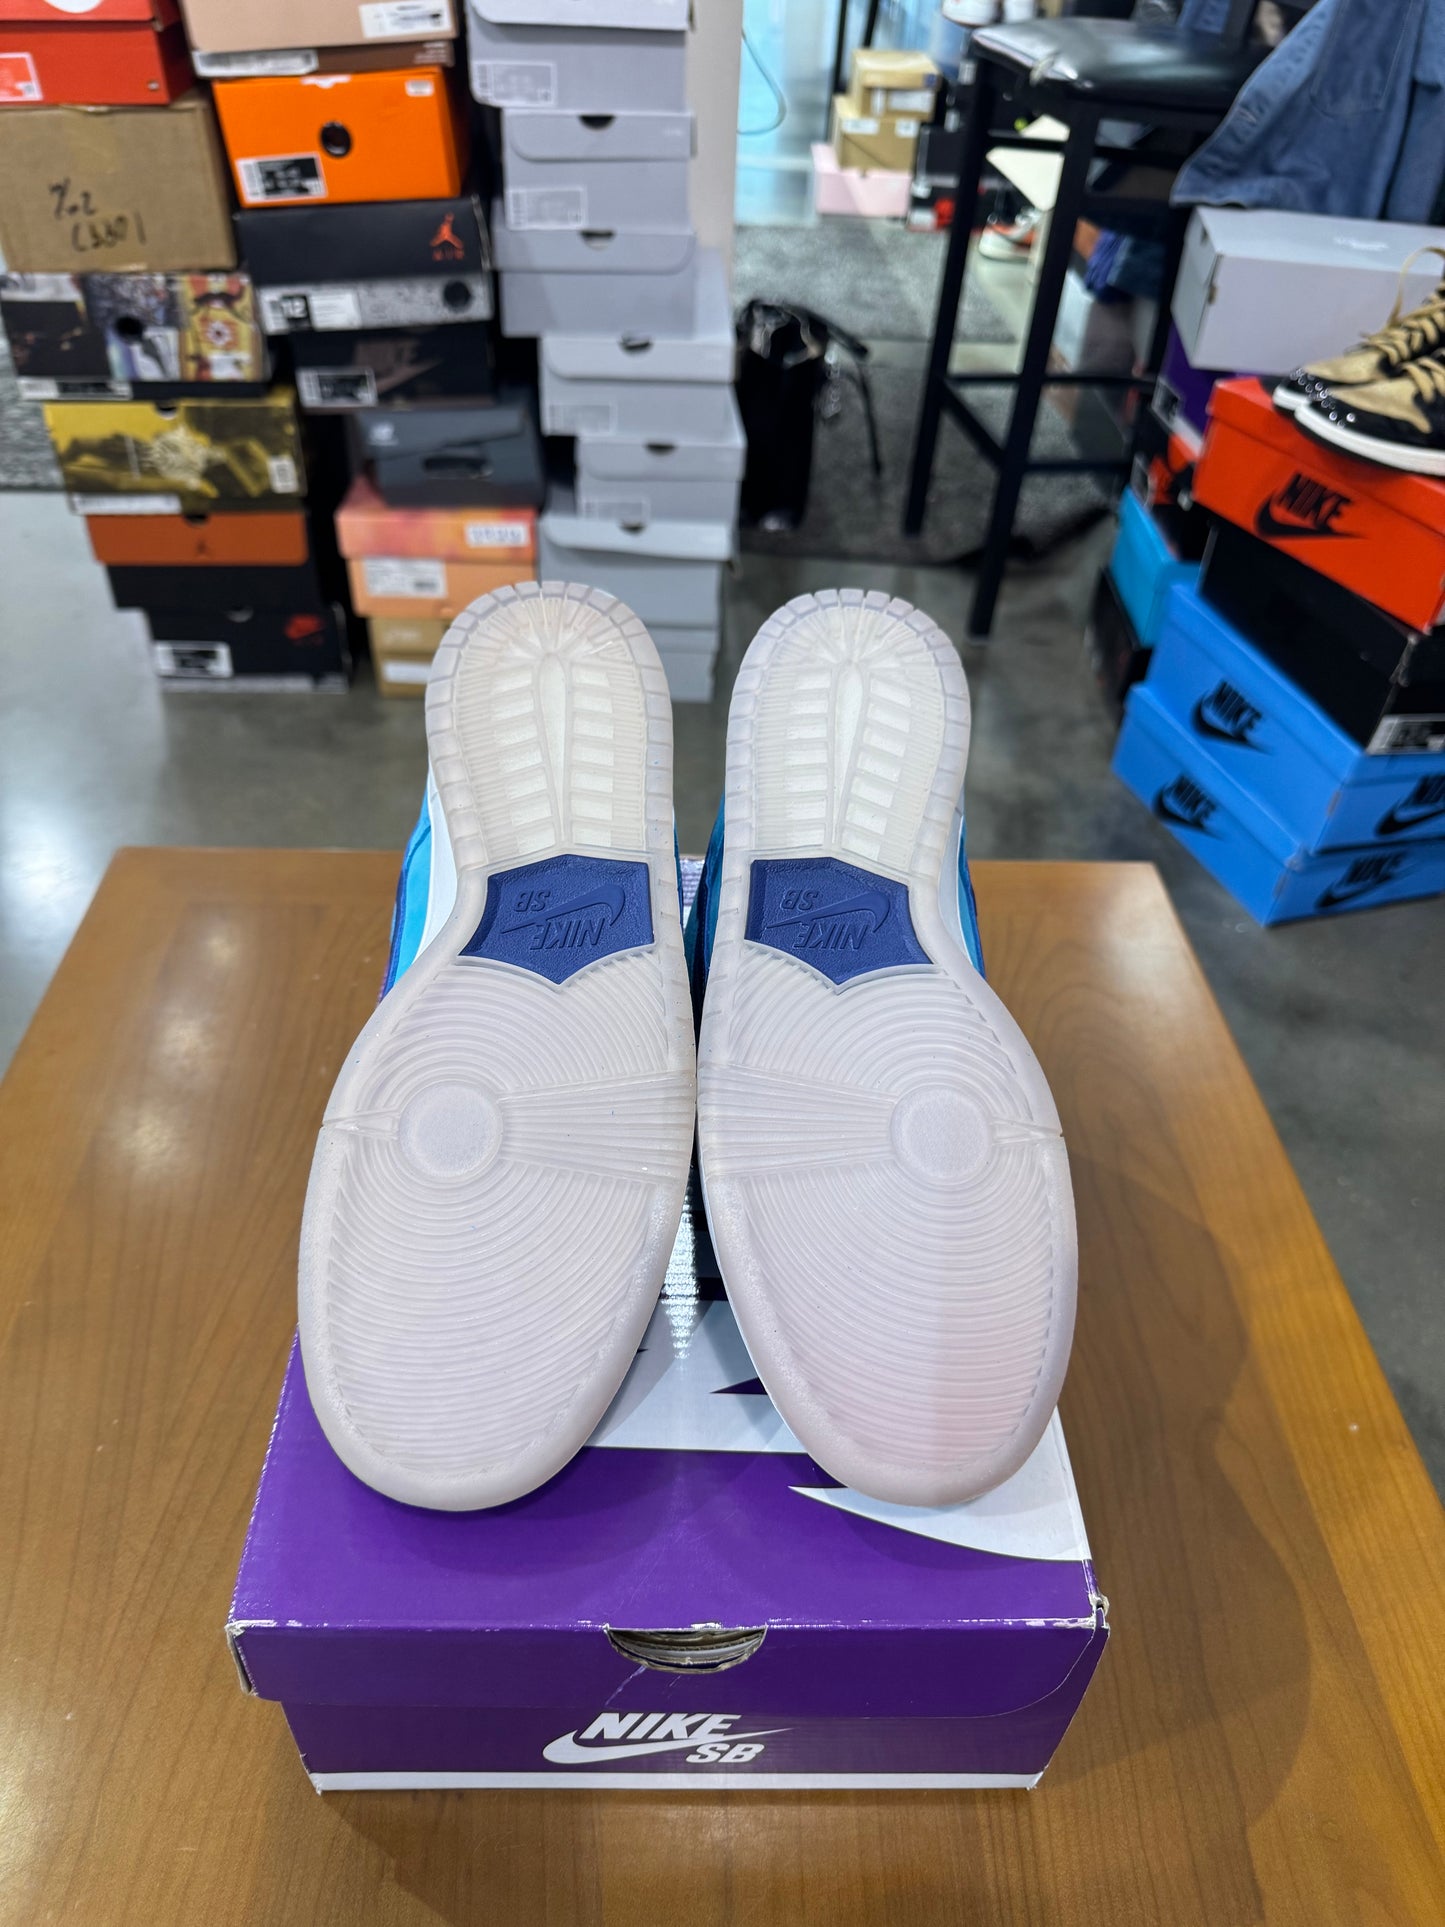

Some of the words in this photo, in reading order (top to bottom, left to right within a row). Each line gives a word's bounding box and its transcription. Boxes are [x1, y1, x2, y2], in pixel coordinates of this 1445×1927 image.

[1278, 472, 1352, 526] NIKE
[1204, 681, 1262, 735] NIKE
[1166, 775, 1217, 821] NIKE
[514, 890, 552, 912] SB
[780, 889, 820, 911] SB
[529, 917, 606, 951] NIKE
[792, 921, 871, 951] NIKE
[579, 1712, 742, 1740] NIKE
[685, 1743, 765, 1763] SB
